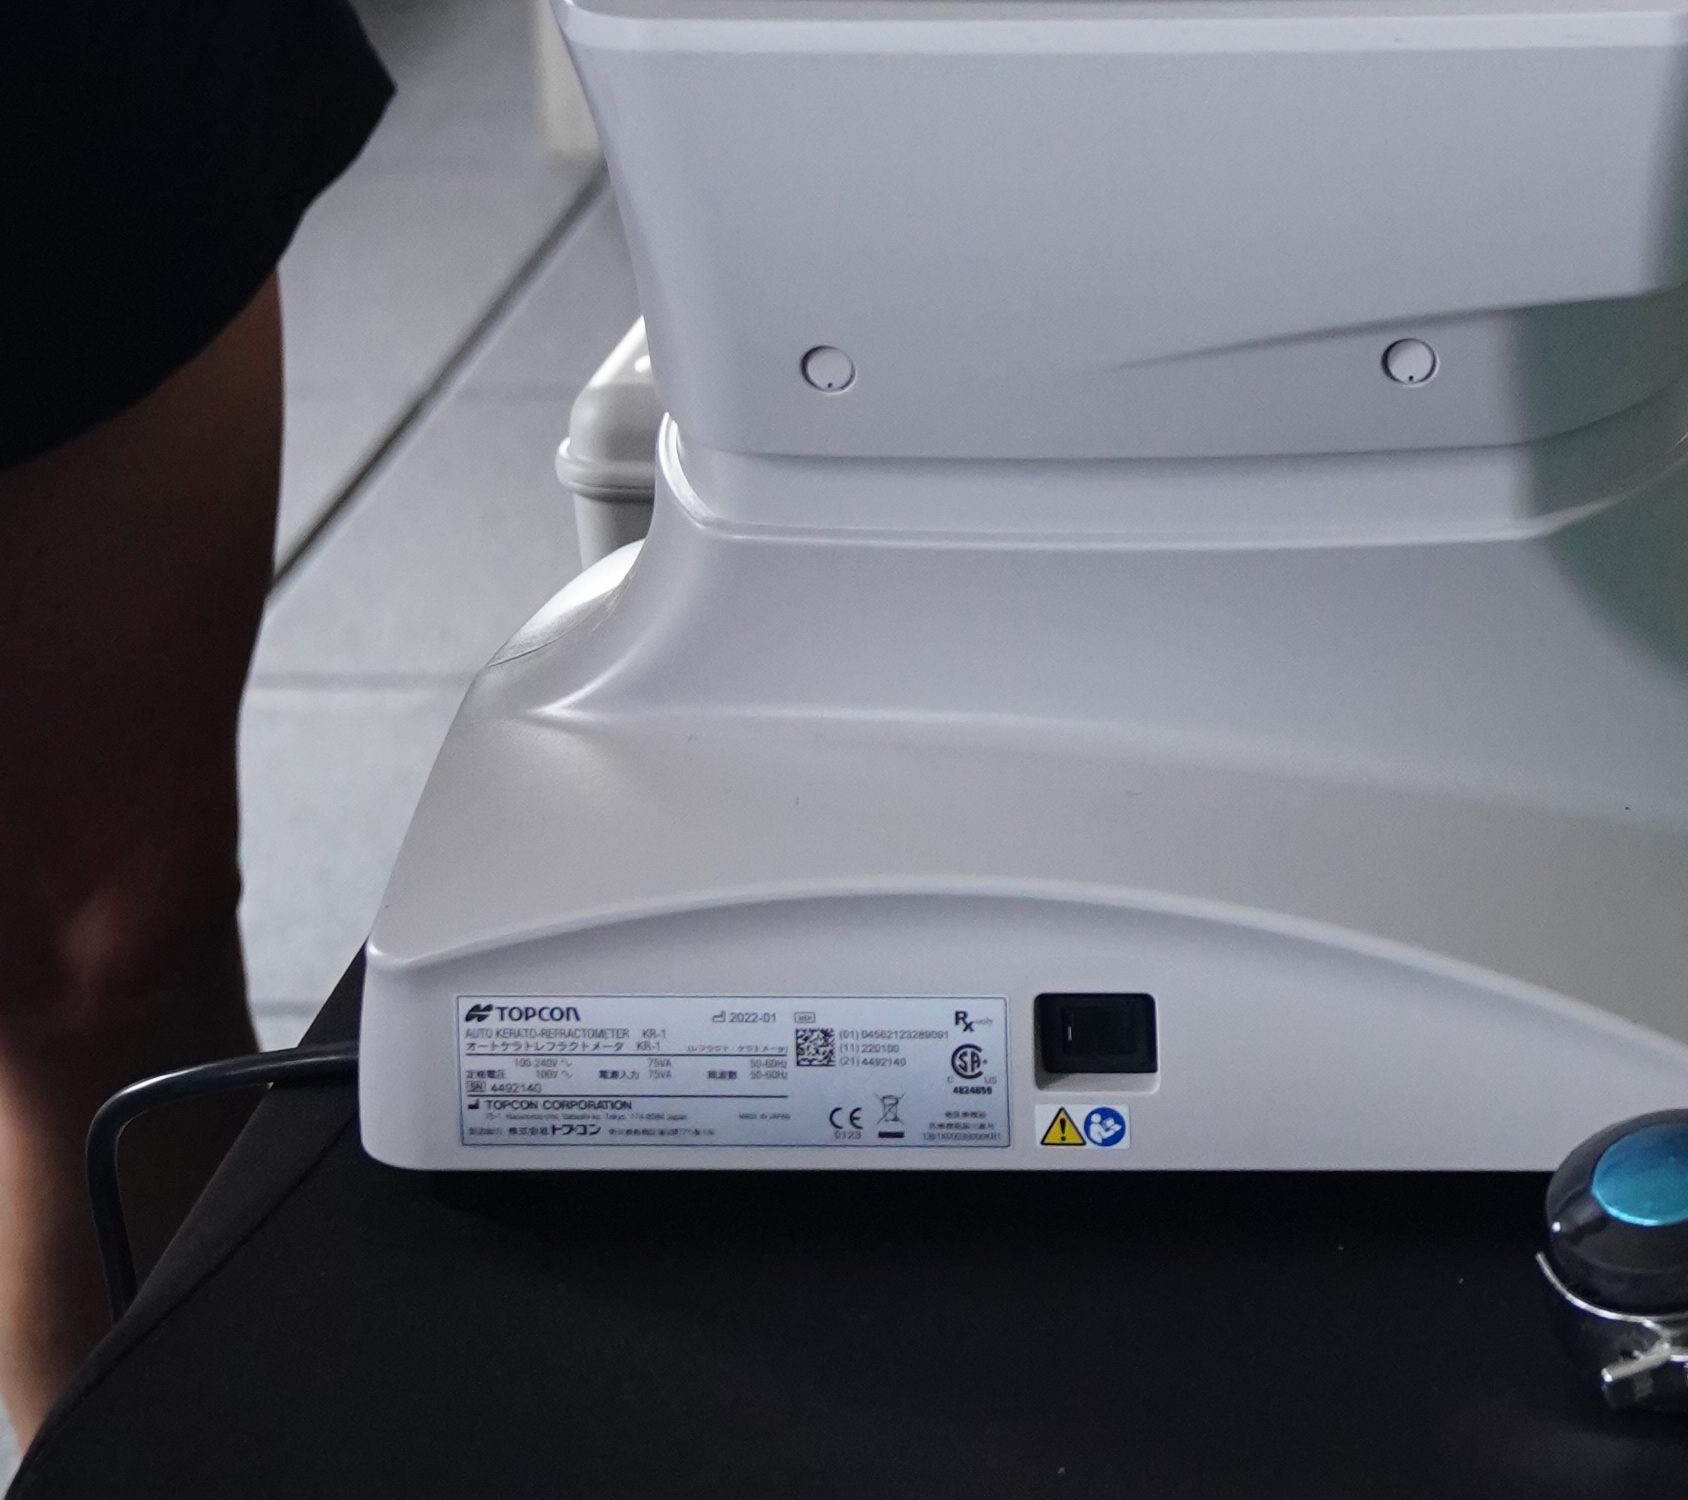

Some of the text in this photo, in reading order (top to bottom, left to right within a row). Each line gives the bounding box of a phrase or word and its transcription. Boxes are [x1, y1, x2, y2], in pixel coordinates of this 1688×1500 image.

[495, 1006, 580, 1022] TOPCON
[729, 1013, 777, 1023] 2022-01
[466, 1028, 666, 1039] AUTO KERATO-REFRACTOMETER KR-1
[466, 1041, 661, 1052] オートケラトレフラクトメータ KR-1
[491, 1084, 542, 1093] 4492140
[485, 1100, 633, 1110] TOPCON CORPORATION
